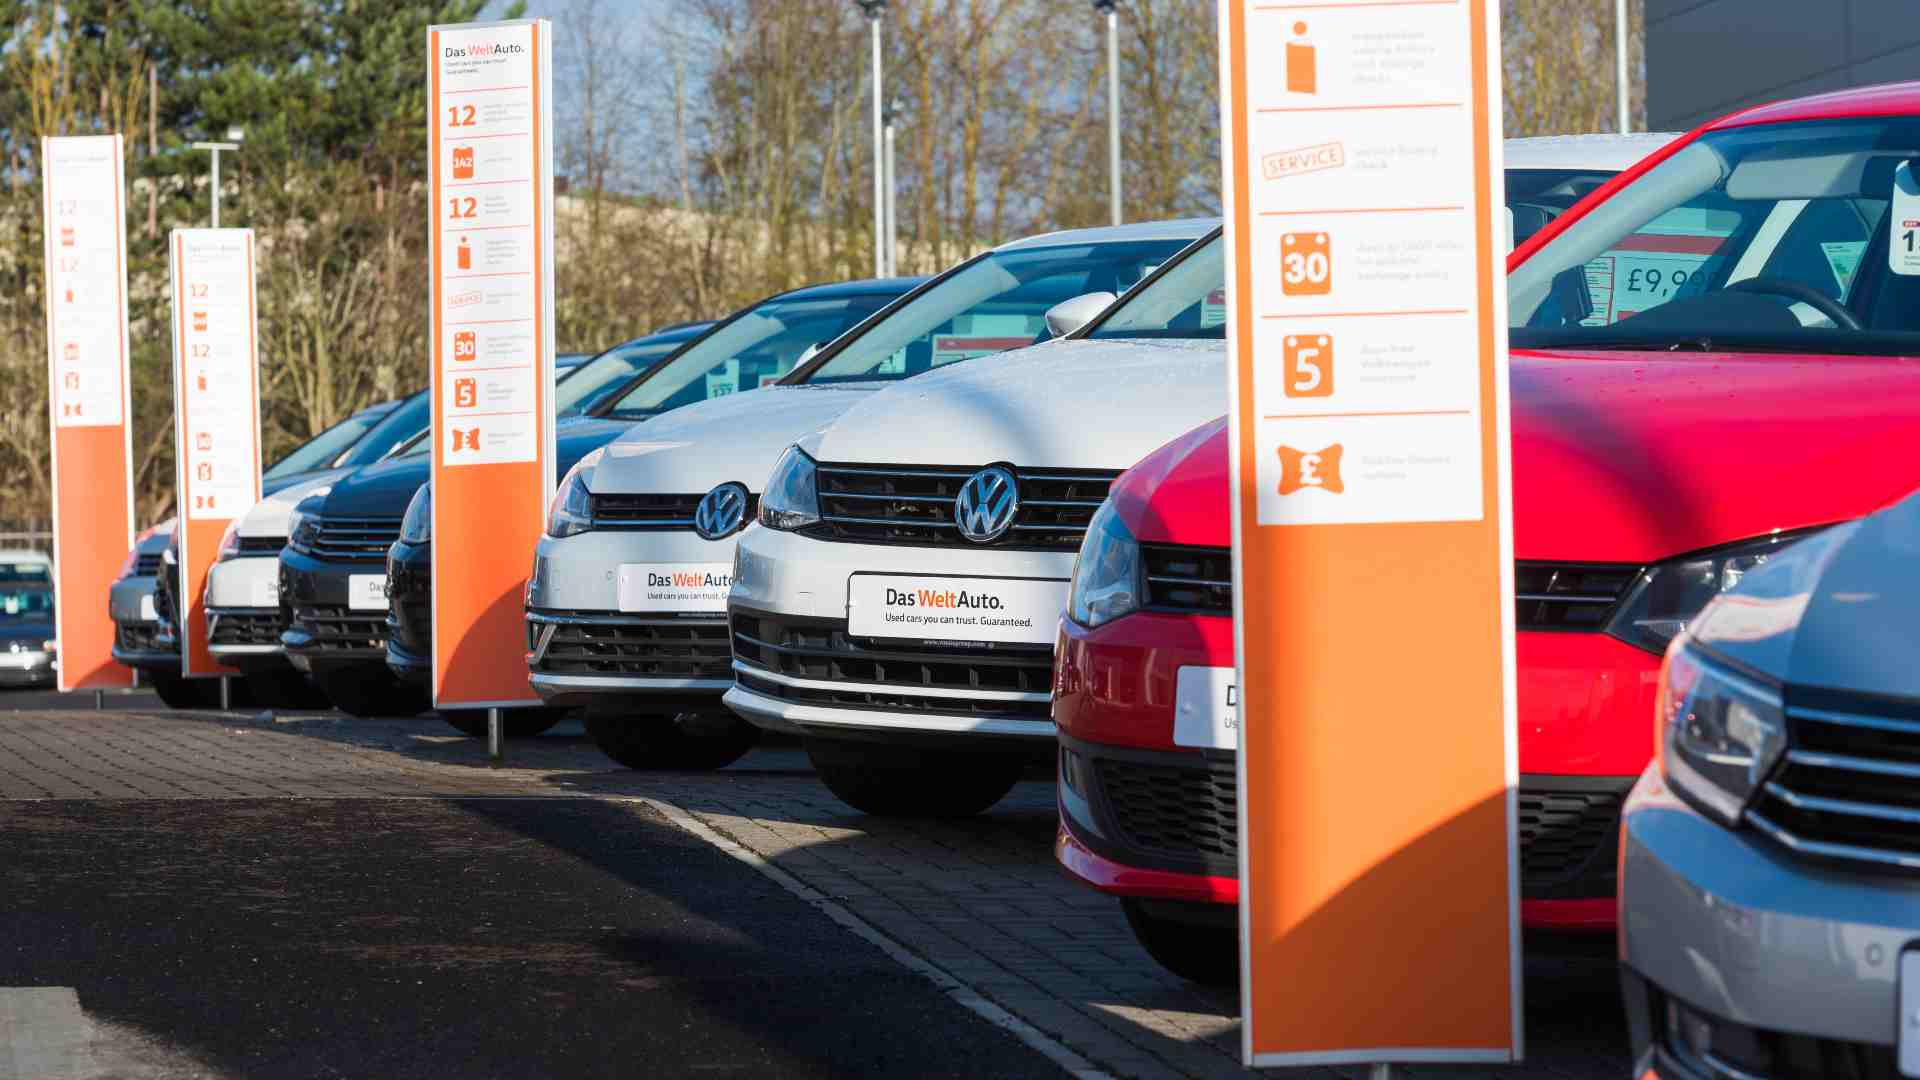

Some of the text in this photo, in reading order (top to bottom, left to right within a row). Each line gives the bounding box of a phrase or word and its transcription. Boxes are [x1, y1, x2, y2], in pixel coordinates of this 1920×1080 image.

[445, 43, 525, 58] Das WeltAuto.
[448, 104, 477, 127] 12
[1268, 148, 1338, 175] SERVICE
[449, 196, 478, 219] 12
[1902, 229, 1920, 252] 1
[1283, 251, 1329, 284] 30
[455, 340, 474, 356] 30
[1293, 347, 1322, 391] 5
[459, 384, 473, 406] 5
[648, 572, 671, 587] Das
[886, 588, 1005, 610] Das WeltAuto.
[885, 612, 1033, 628] Used cars you can trust. Guaranteed.
